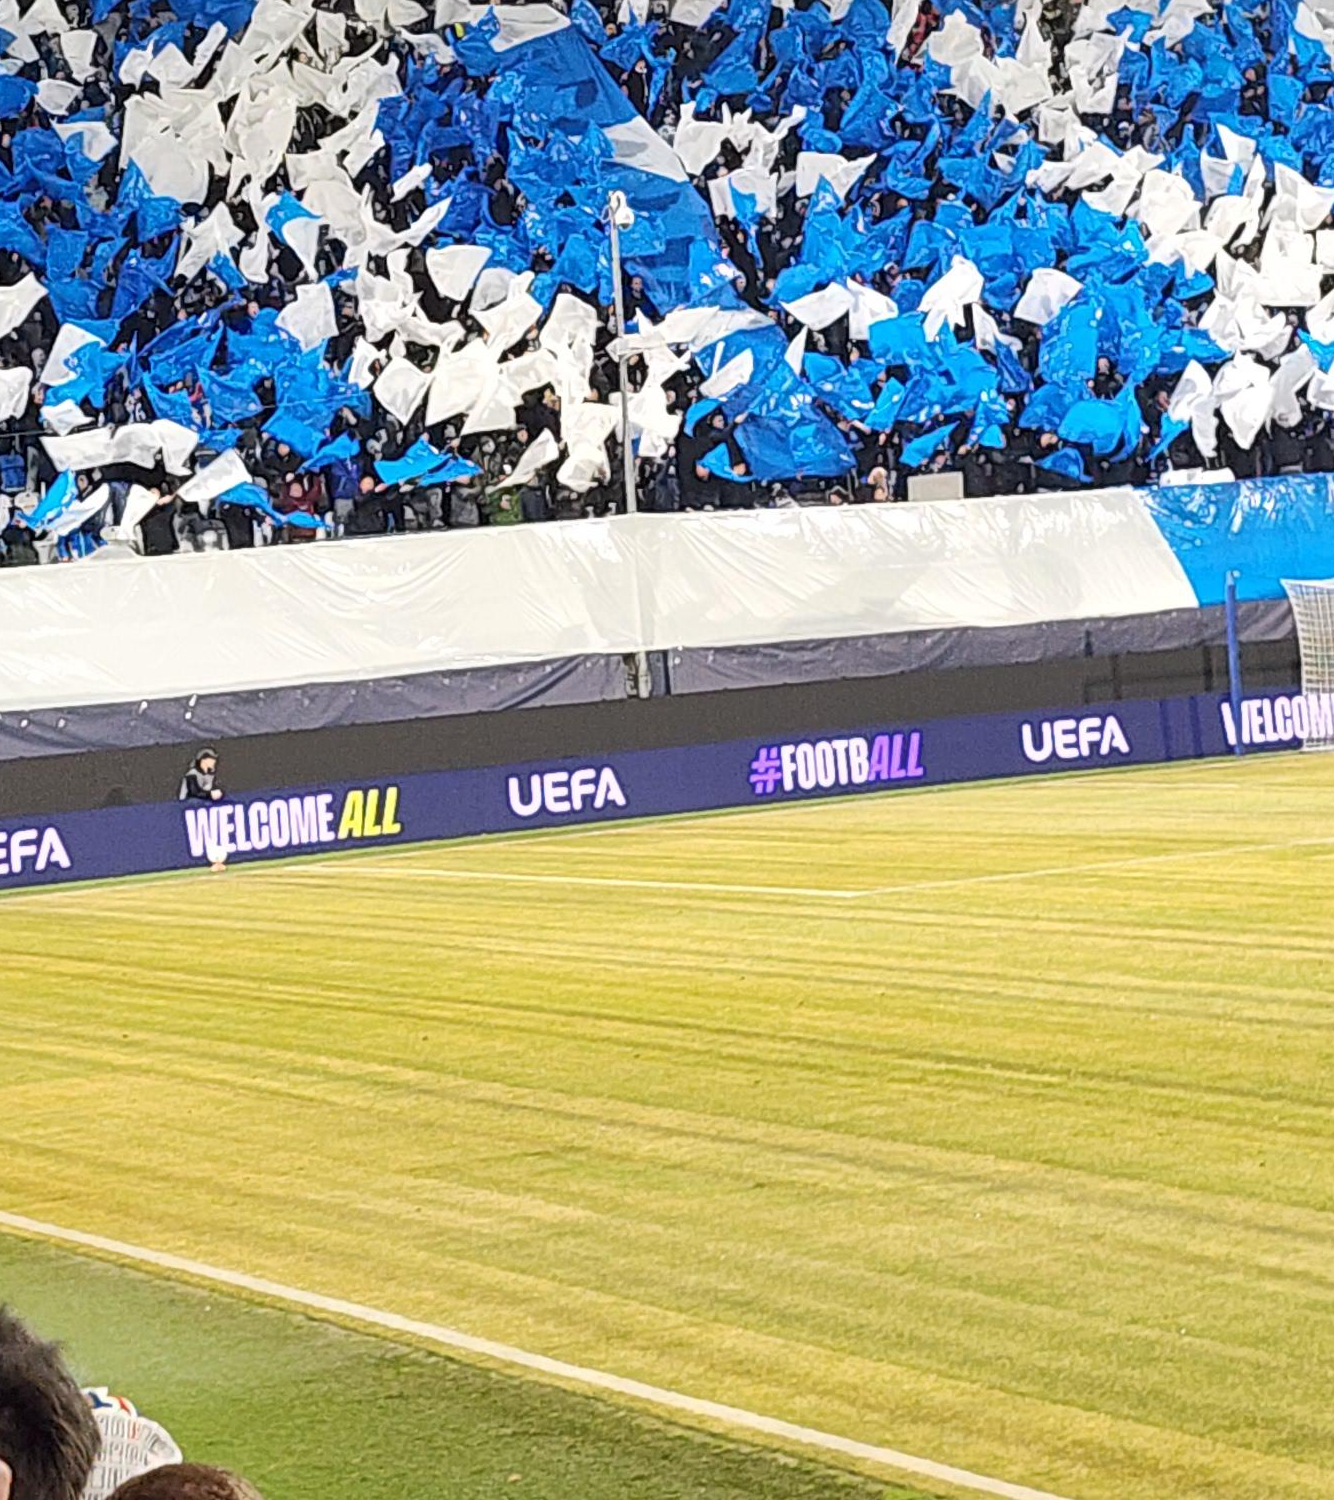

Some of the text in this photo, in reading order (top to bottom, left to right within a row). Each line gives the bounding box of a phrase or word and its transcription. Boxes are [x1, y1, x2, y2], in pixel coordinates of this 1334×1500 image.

[750, 732, 924, 794] #FOOTBALL
[1021, 715, 1130, 762] UEFA
[508, 767, 627, 817] UEFA
[185, 787, 401, 857] WELCOME ALL
